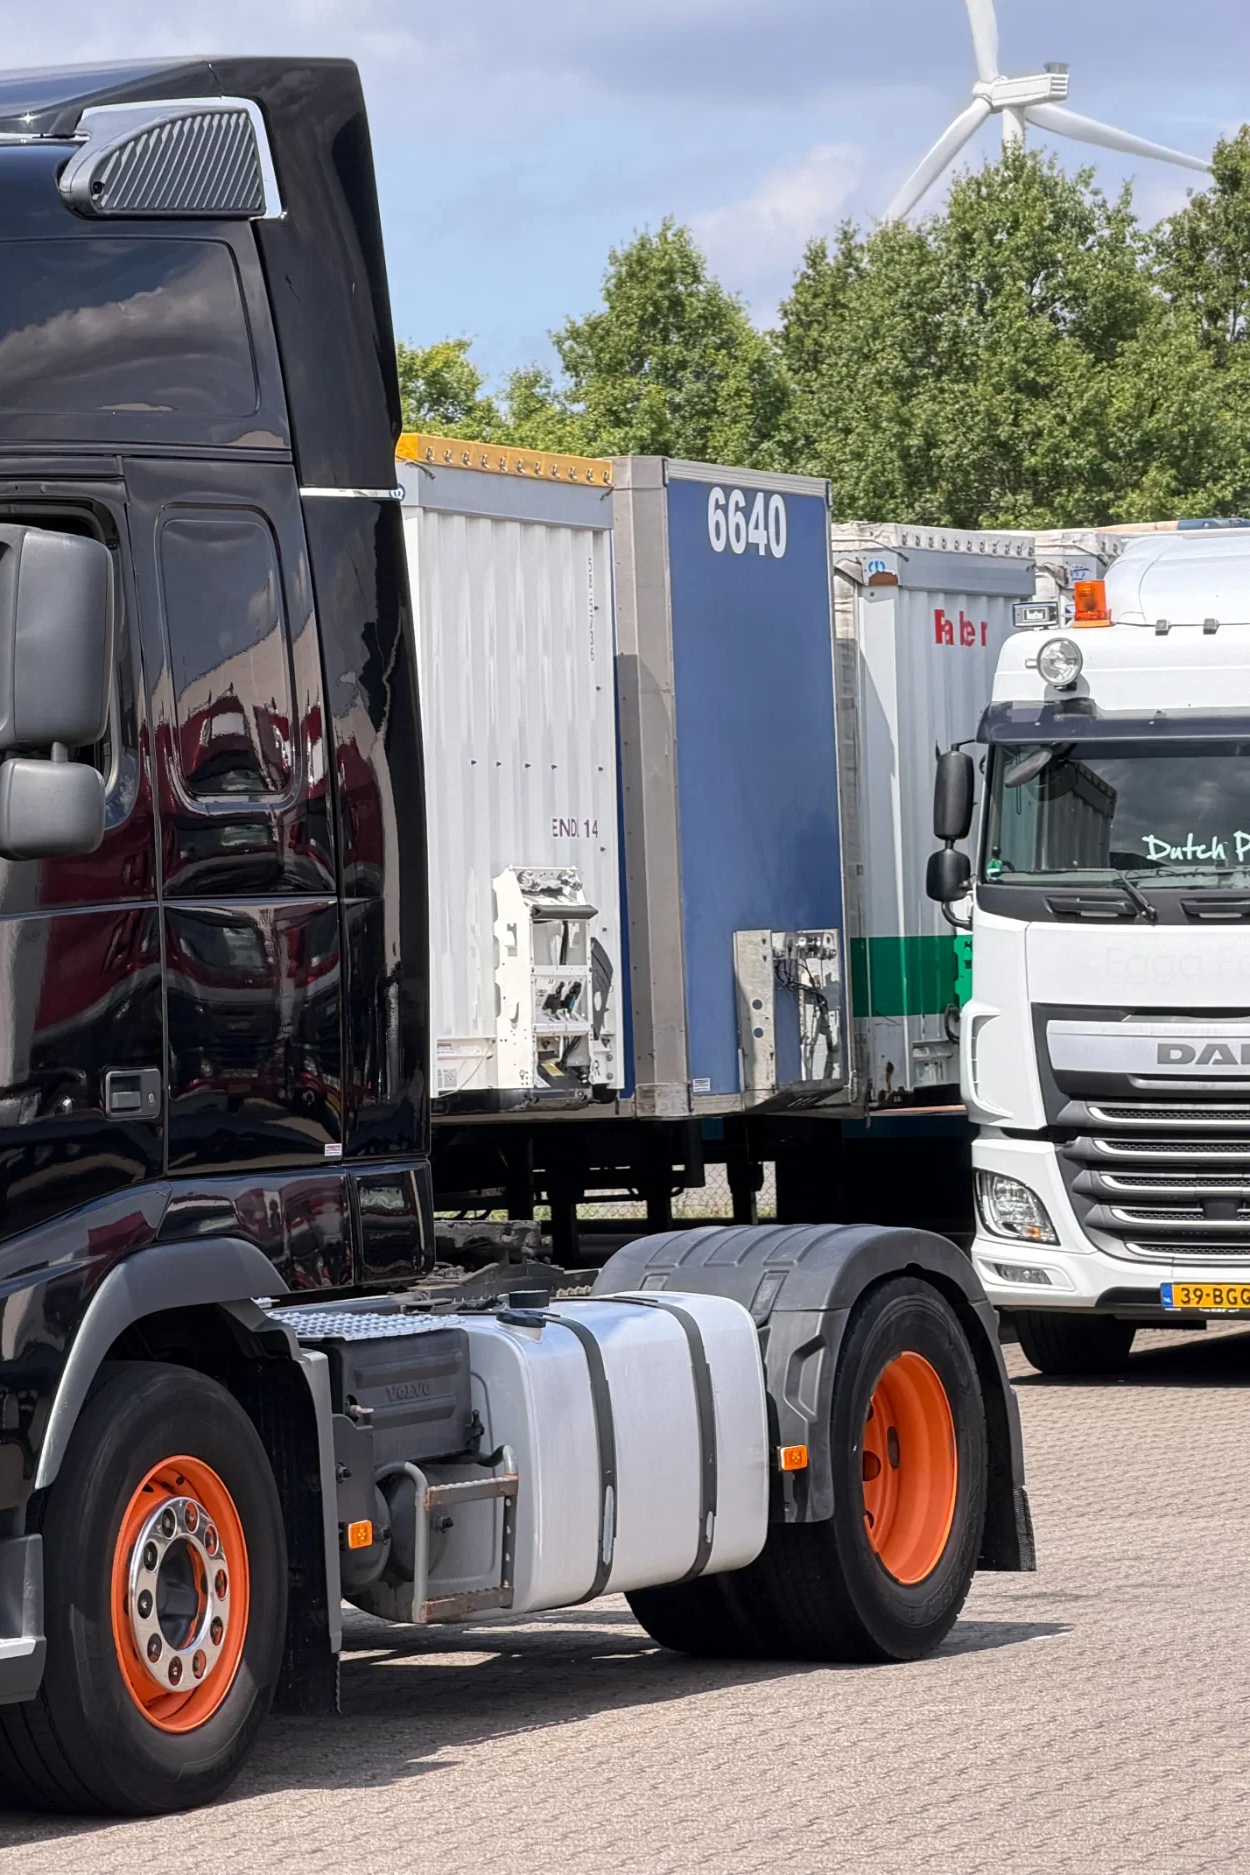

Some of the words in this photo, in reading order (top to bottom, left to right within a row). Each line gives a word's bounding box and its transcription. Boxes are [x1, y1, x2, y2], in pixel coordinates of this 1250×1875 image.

[708, 487, 787, 558] 6640
[934, 609, 988, 647] Faber
[1141, 832, 1226, 860] Dutch
[386, 1382, 431, 1402] VOLVO
